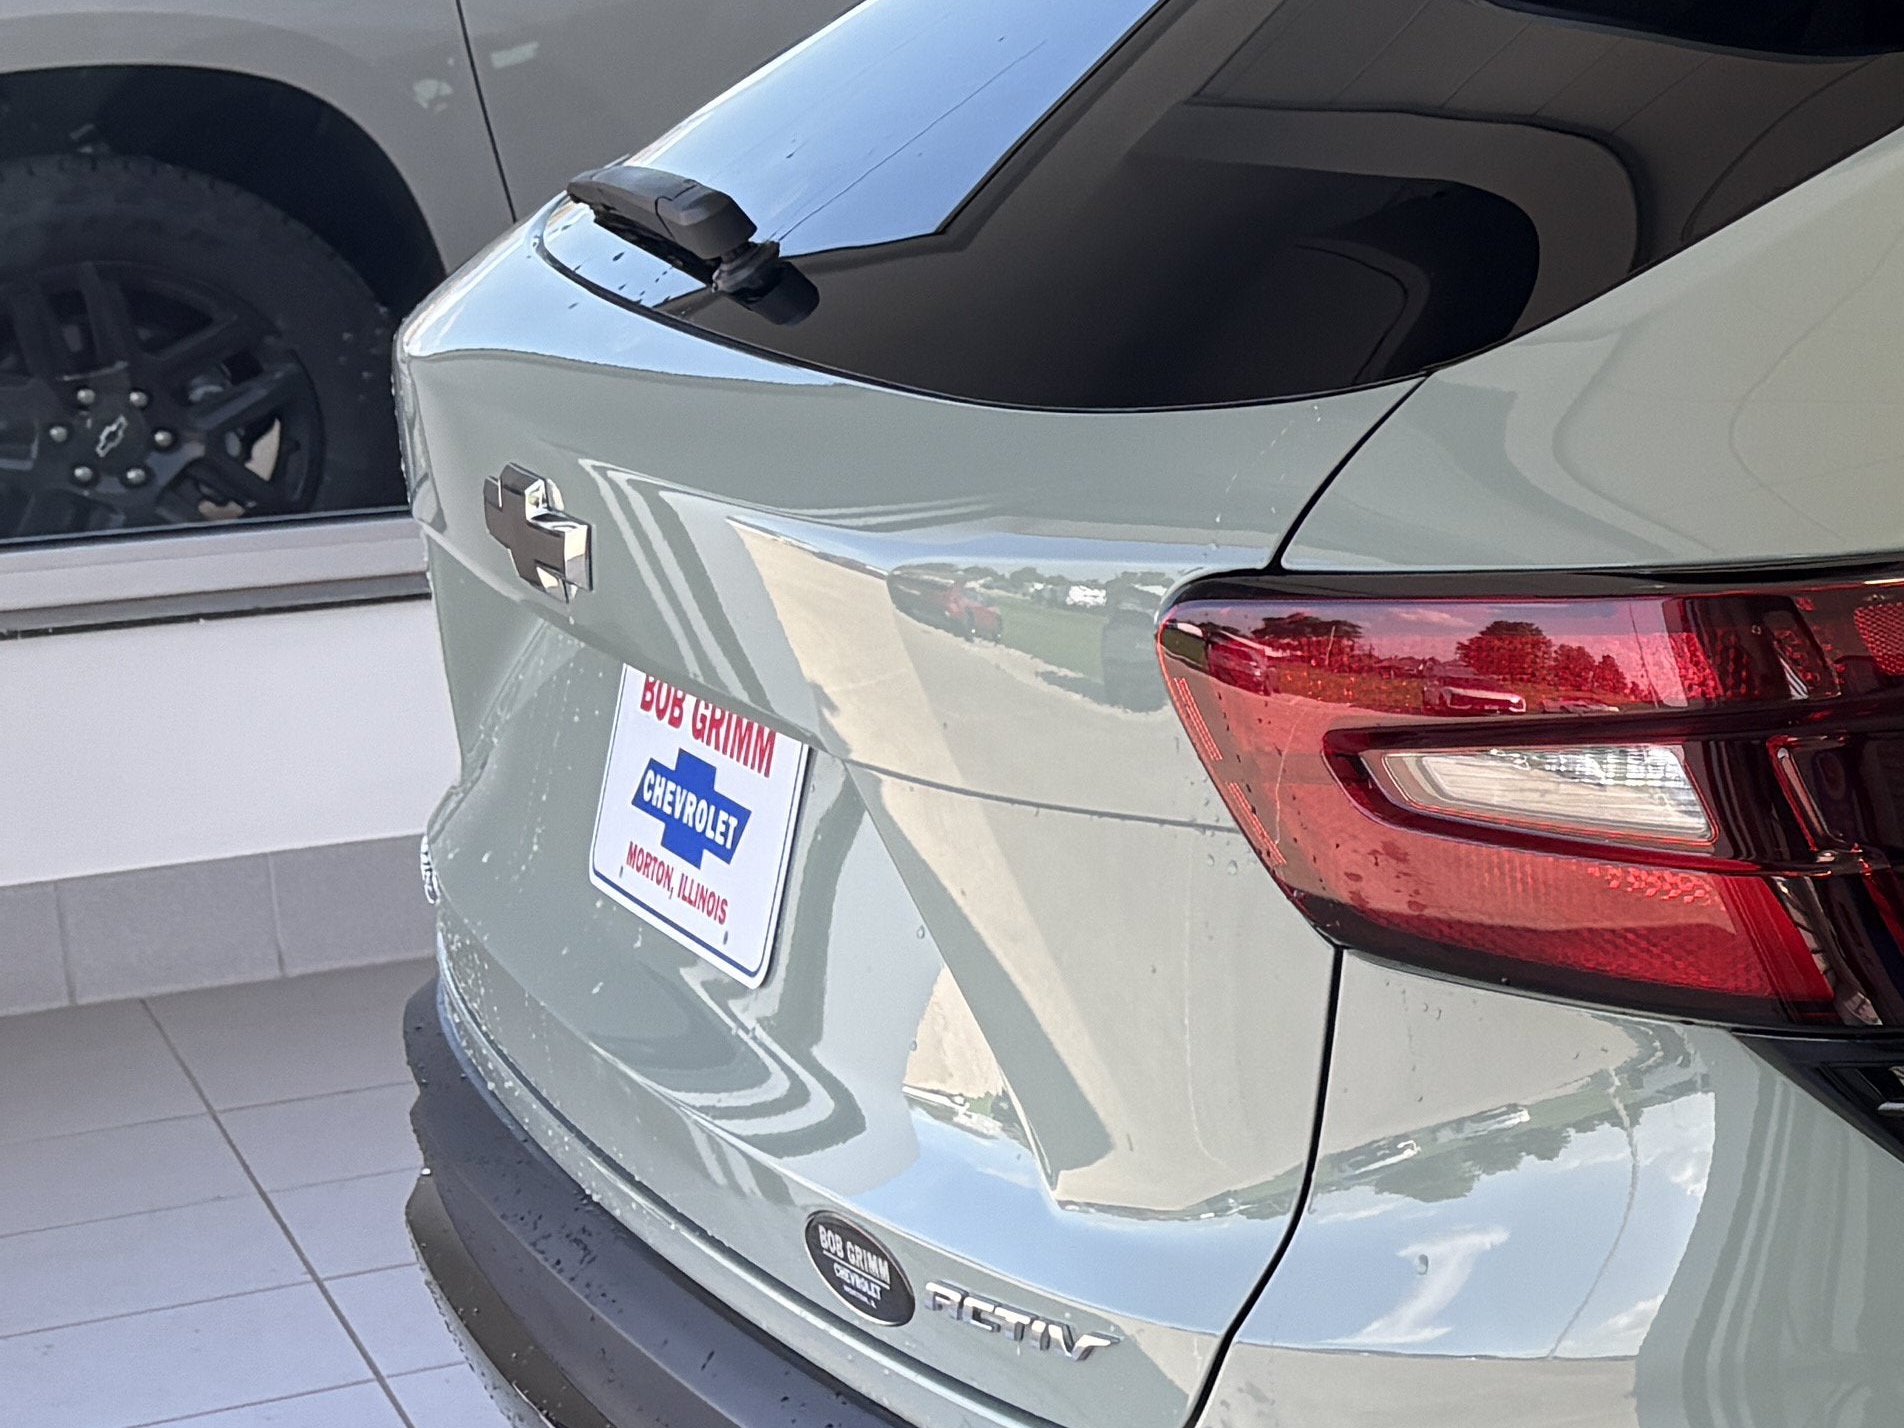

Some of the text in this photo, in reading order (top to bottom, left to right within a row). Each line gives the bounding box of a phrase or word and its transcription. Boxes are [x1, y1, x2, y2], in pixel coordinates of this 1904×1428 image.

[640, 675, 776, 778] BOB GRIMM
[642, 769, 739, 851] CHEVROLET
[626, 841, 729, 925] MORTON, ILLINOIS
[817, 1224, 891, 1285] BOB GRIMM
[924, 1279, 1122, 1362] ACTIV
